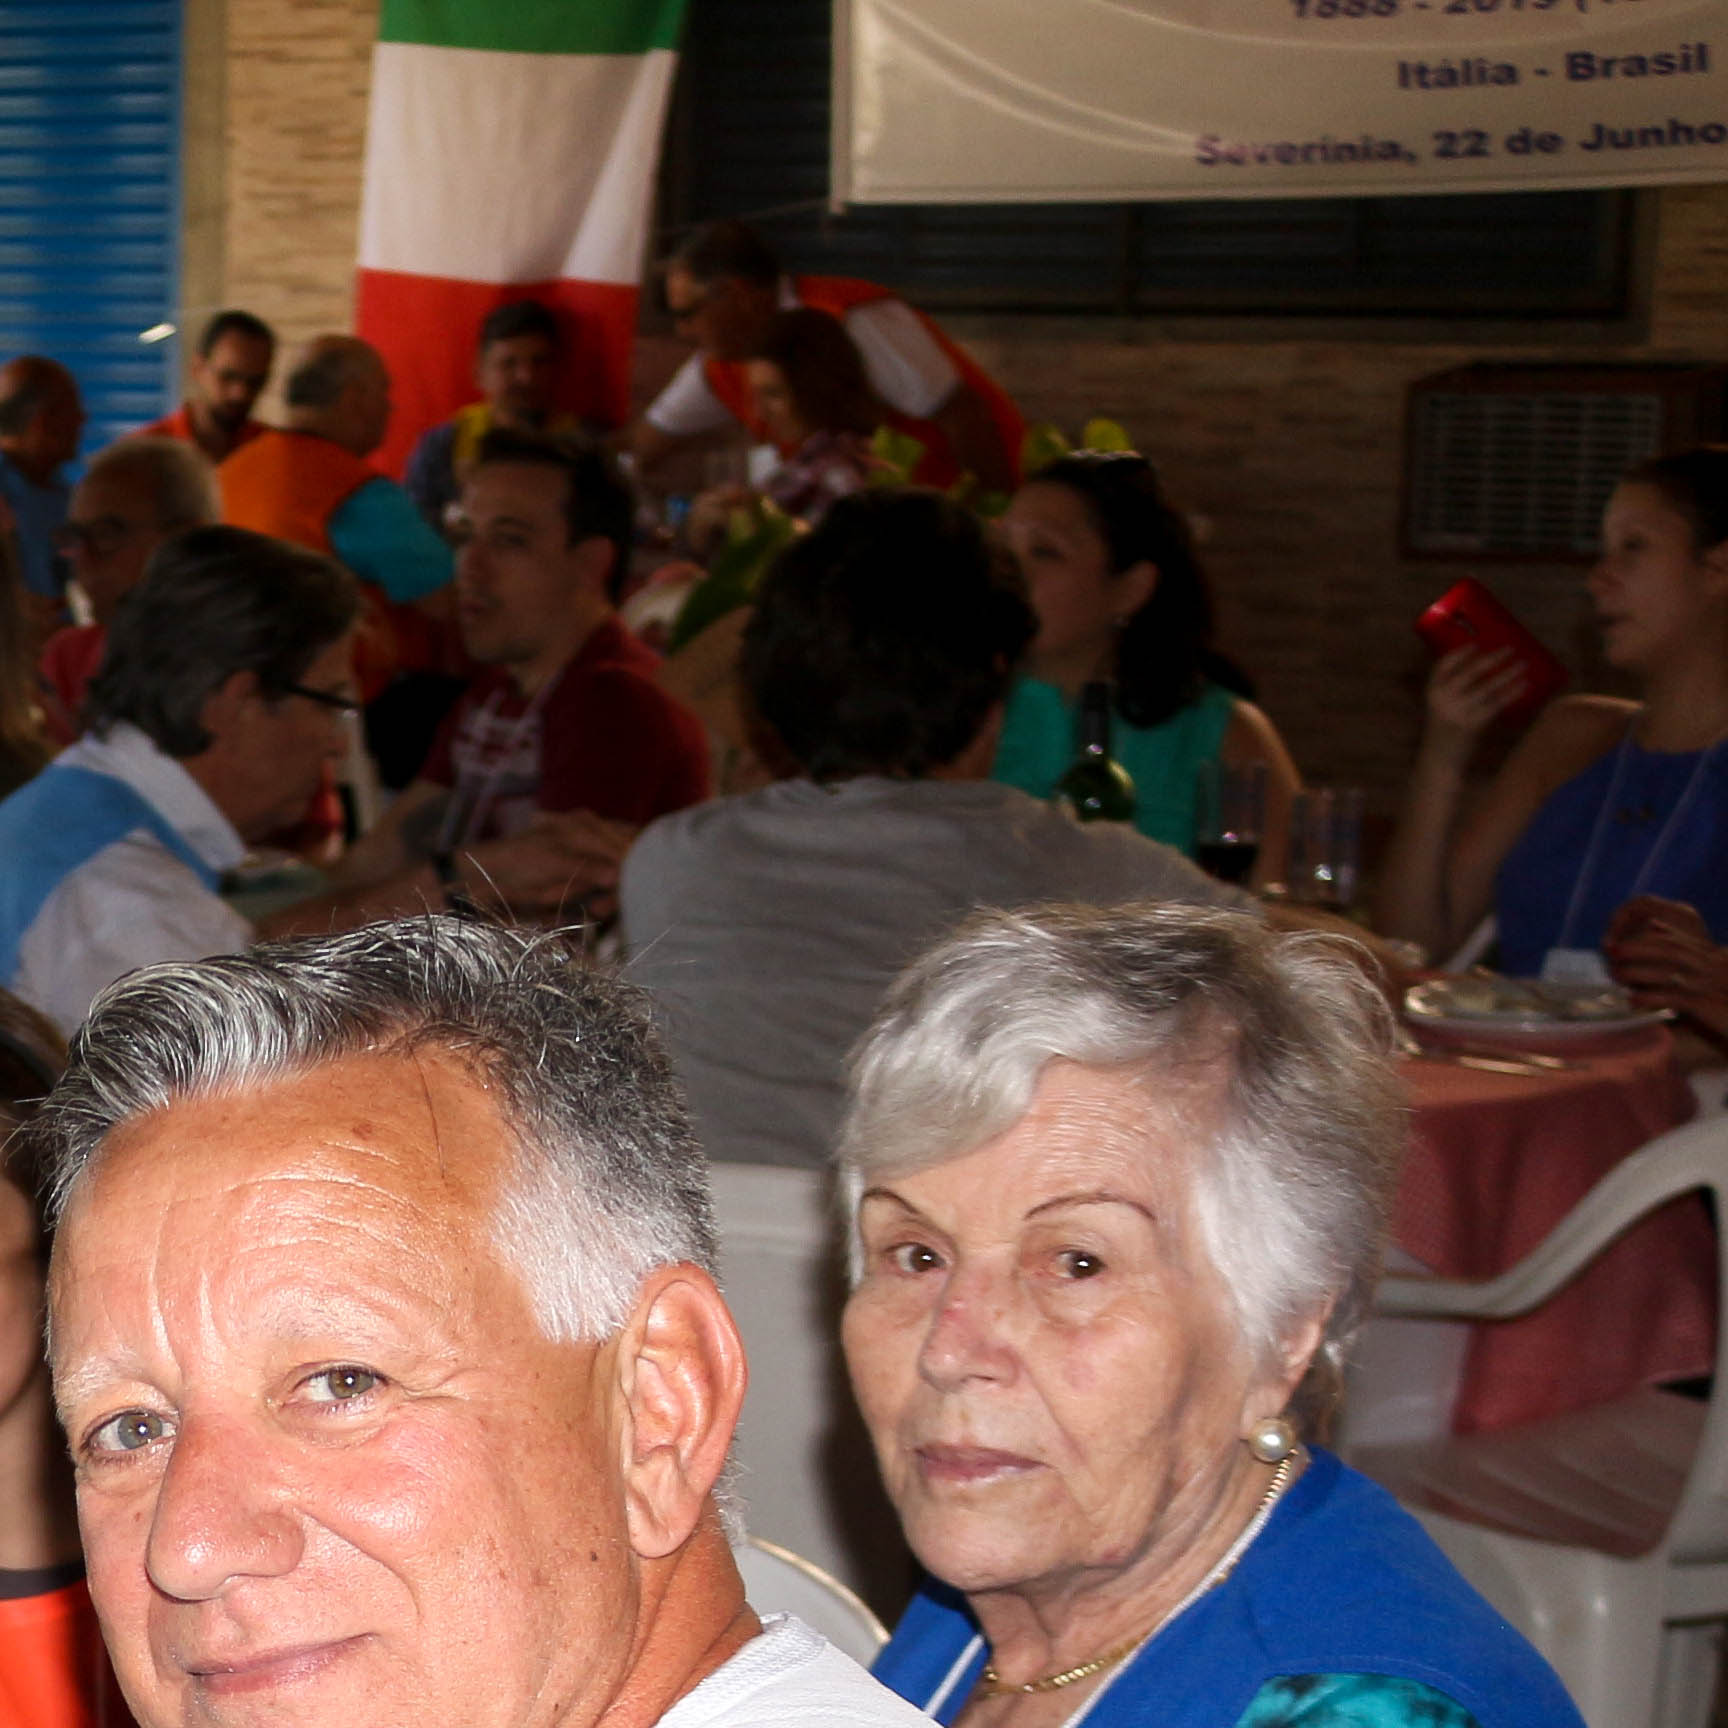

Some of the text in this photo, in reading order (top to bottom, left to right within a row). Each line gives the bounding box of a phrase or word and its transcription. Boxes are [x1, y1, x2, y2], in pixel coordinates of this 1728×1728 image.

[1396, 58, 1520, 90] Itália
[1564, 43, 1711, 83] Brasil
[1433, 130, 1491, 160] 22
[1506, 127, 1564, 156] de
[1579, 118, 1728, 152] Junho
